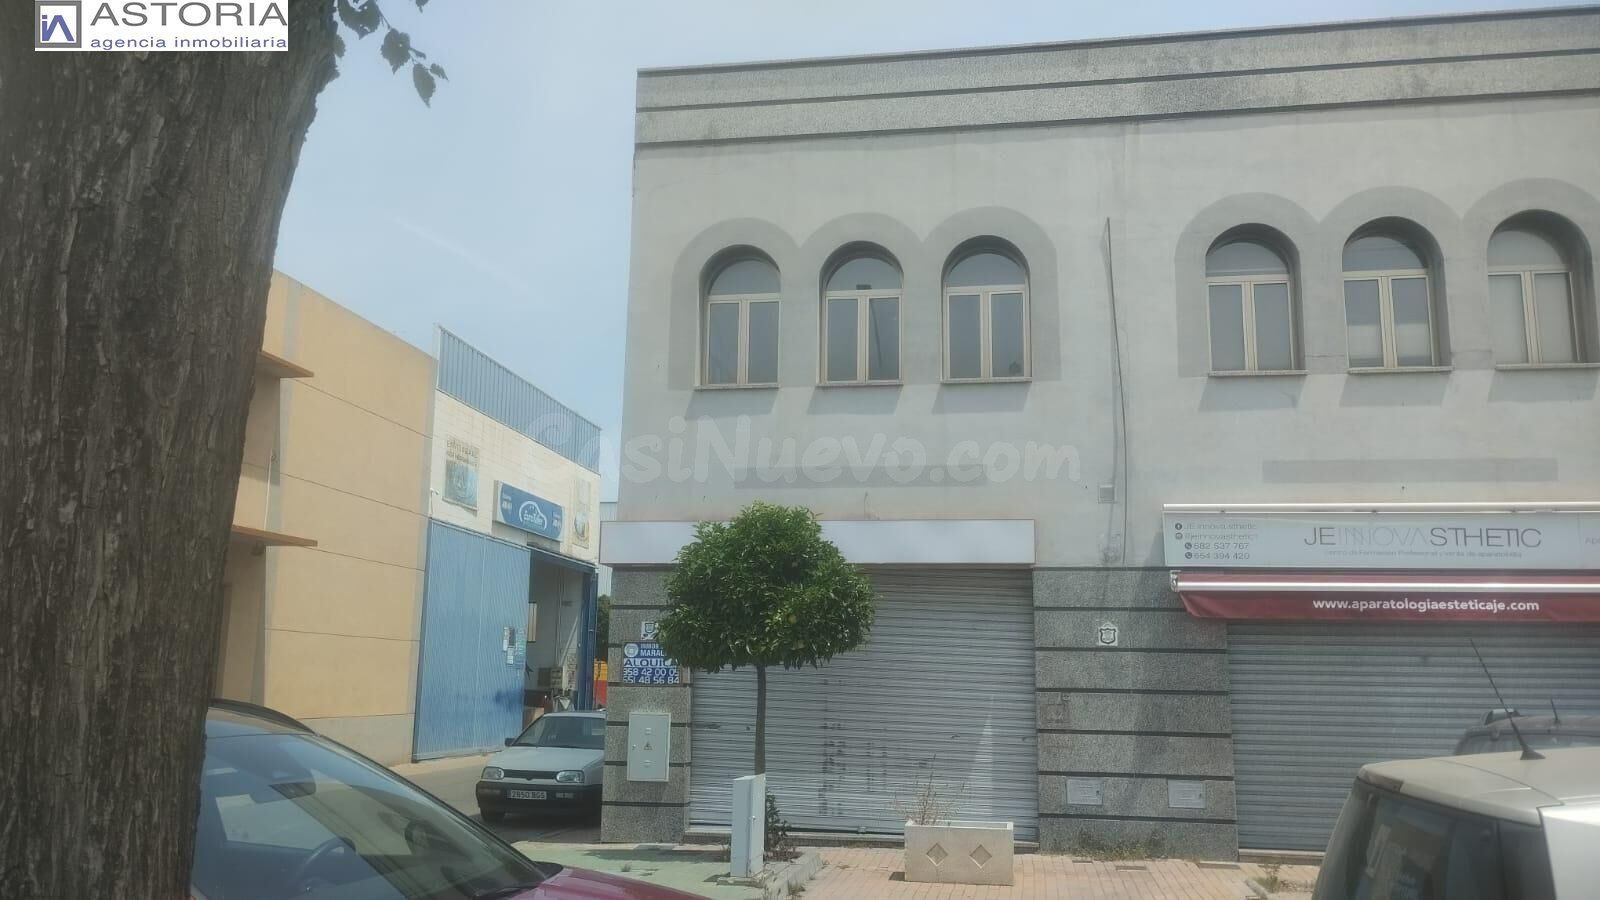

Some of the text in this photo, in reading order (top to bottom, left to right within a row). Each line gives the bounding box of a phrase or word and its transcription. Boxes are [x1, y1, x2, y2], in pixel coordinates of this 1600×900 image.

[1193, 542, 1211, 550] 682
[1213, 542, 1231, 550] 537
[1193, 552, 1250, 560] 654 394 420
[1312, 598, 1541, 612] www.aparatologiaesteticaje.com
[641, 668, 653, 676] 42
[654, 668, 667, 676] 00
[638, 676, 651, 684] 48
[653, 676, 665, 684] 56
[667, 676, 680, 684] 84
